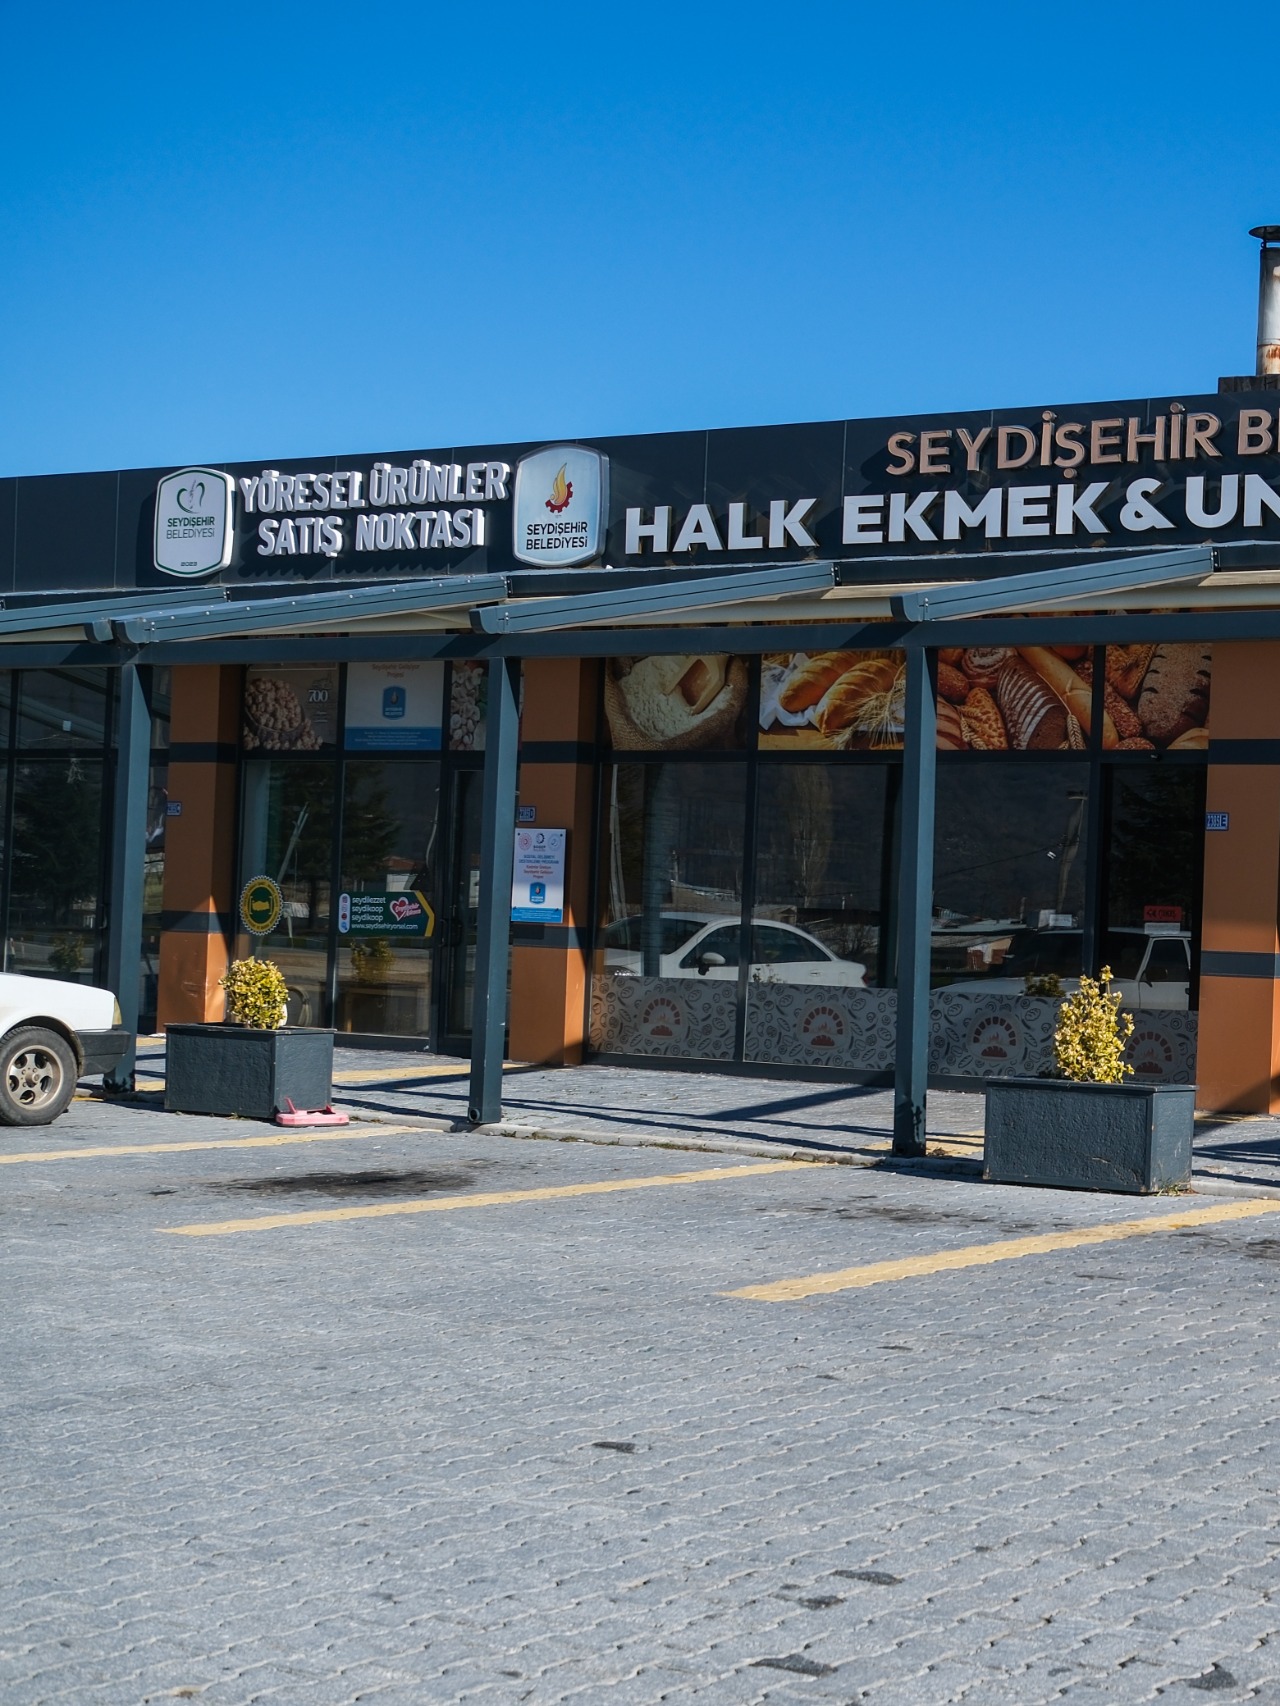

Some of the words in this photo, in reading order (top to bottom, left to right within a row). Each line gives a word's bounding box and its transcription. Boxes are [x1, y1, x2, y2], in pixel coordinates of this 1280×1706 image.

[886, 402, 1222, 478] SEYDİŞEHİR
[240, 469, 369, 513] YÖRESEL
[369, 458, 512, 505] ÜRÜNLER
[167, 516, 216, 528] SEYDİŞEHİR
[625, 498, 819, 554] HALK
[842, 482, 1110, 544] EKMEK
[1119, 477, 1177, 531] &
[166, 528, 216, 540] BELEDİYESİ
[257, 516, 344, 557] SATIŞ
[356, 508, 487, 552] NOKTASI
[526, 521, 588, 536] SEYDİŞEHİR
[526, 536, 588, 550] BELEDİYESİ
[308, 689, 329, 703] 700
